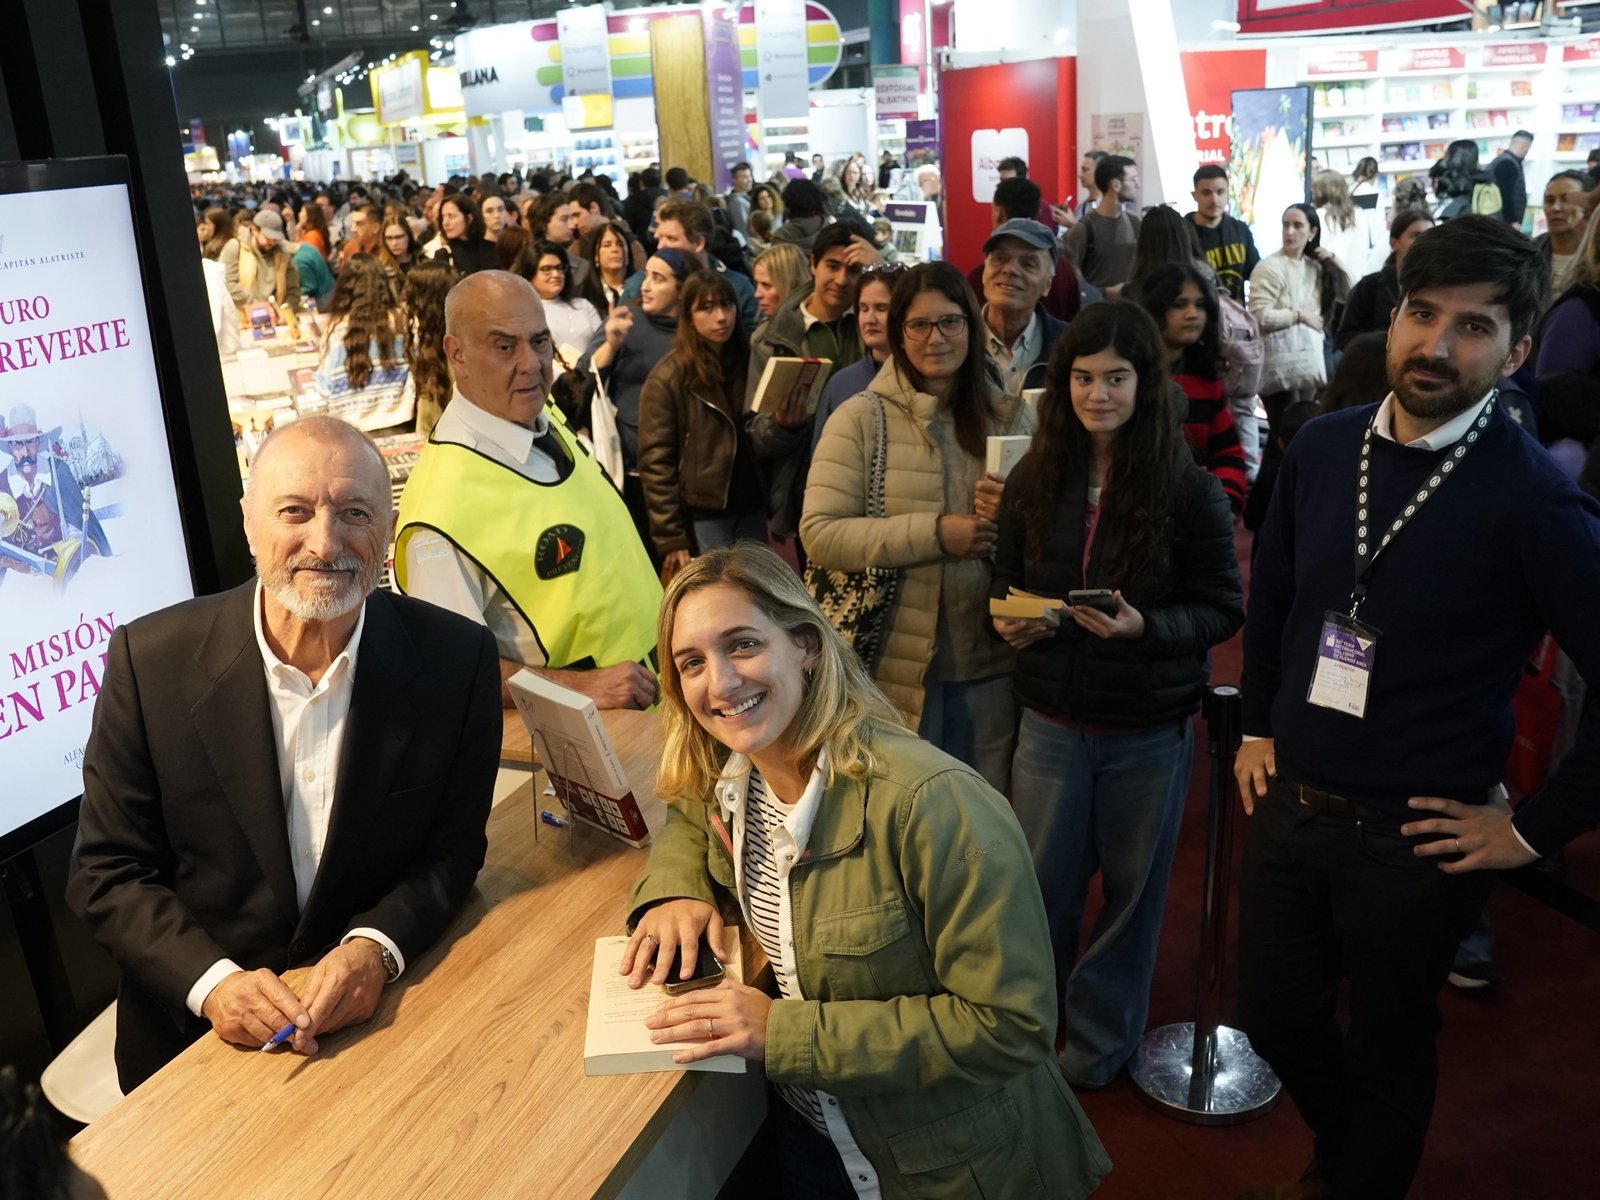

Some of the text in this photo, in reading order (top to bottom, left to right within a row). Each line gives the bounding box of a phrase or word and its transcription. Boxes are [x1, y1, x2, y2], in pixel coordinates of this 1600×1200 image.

[39, 252, 86, 265] ALATRISTE
[0, 295, 50, 325] URO
[0, 318, 131, 374] REVERTE
[9, 612, 117, 680] MISIÓN
